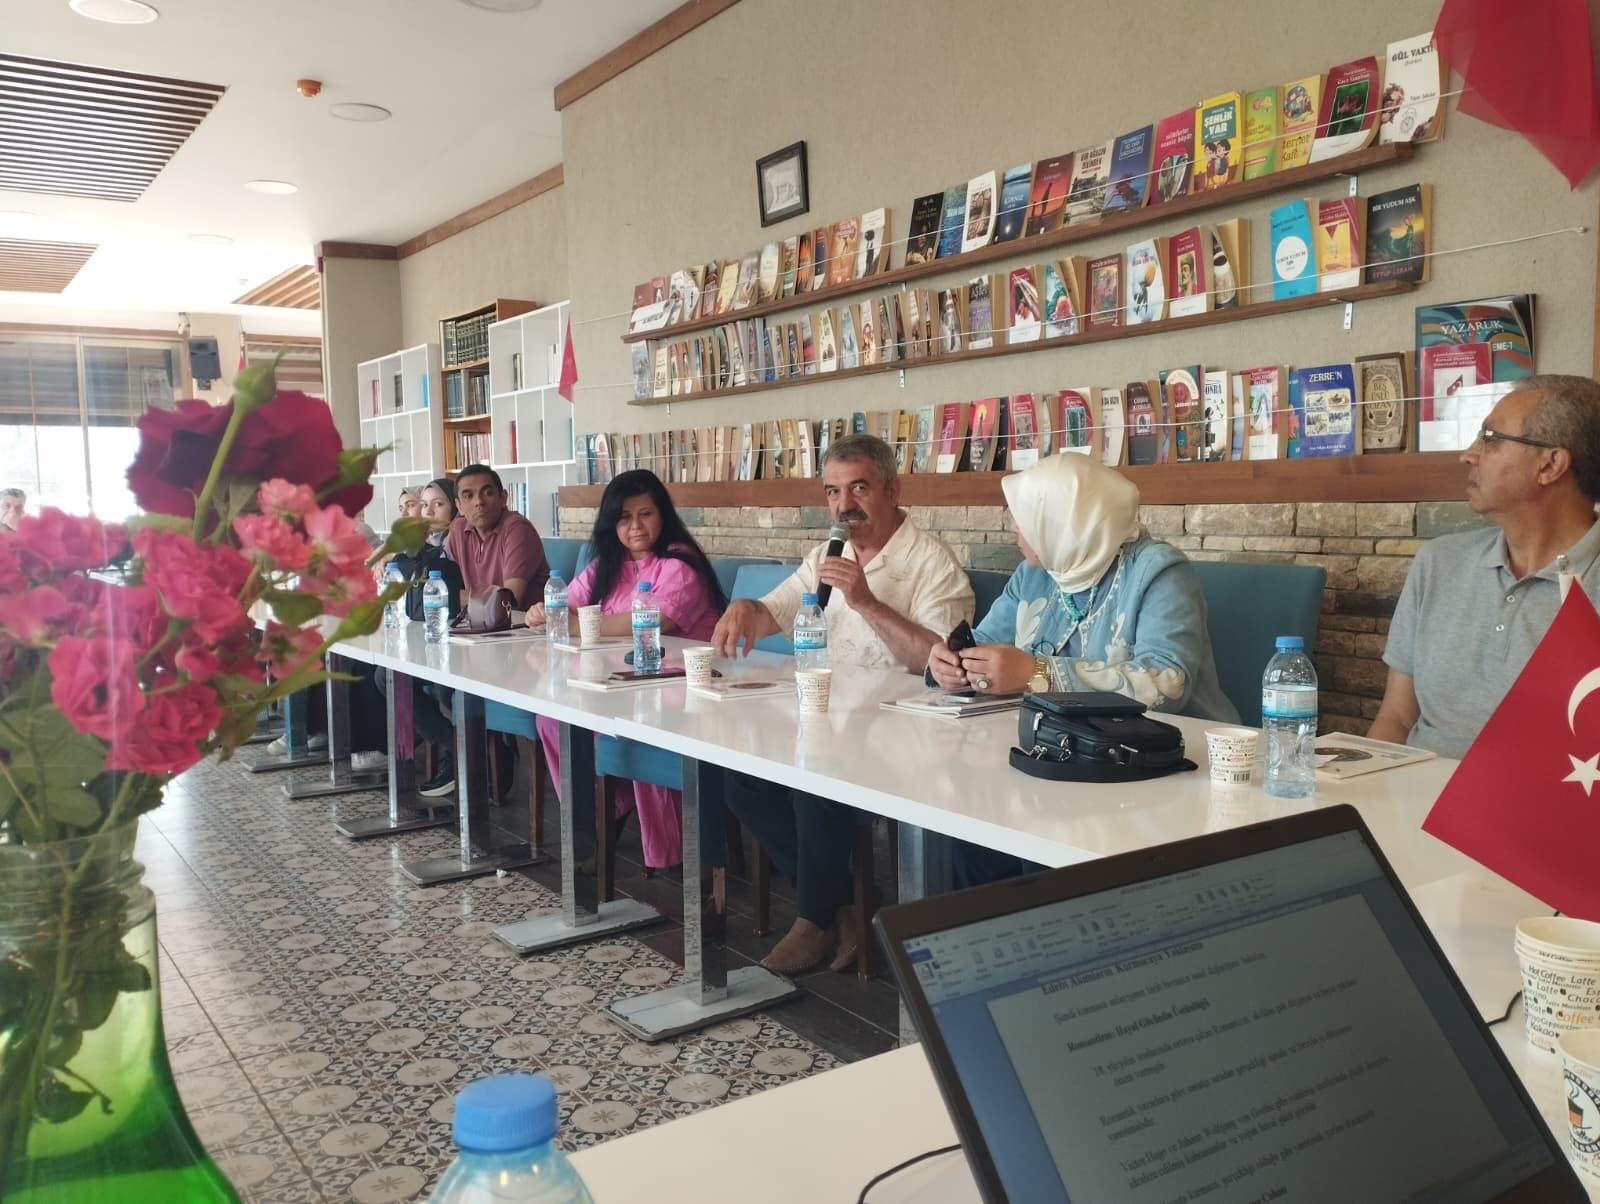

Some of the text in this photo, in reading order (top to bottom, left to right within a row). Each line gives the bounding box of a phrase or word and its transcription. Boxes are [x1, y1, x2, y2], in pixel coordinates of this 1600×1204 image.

[1204, 111, 1233, 128] ŞENLİK
[1209, 123, 1228, 135] VAR
[1441, 320, 1503, 335] YAZARLIK
[1205, 383, 1222, 395] ONRA
[1540, 969, 1566, 983] Coffee
[1571, 975, 1597, 986] Latte
[1536, 982, 1559, 995] Latte
[1555, 1011, 1594, 1025] Coffee
